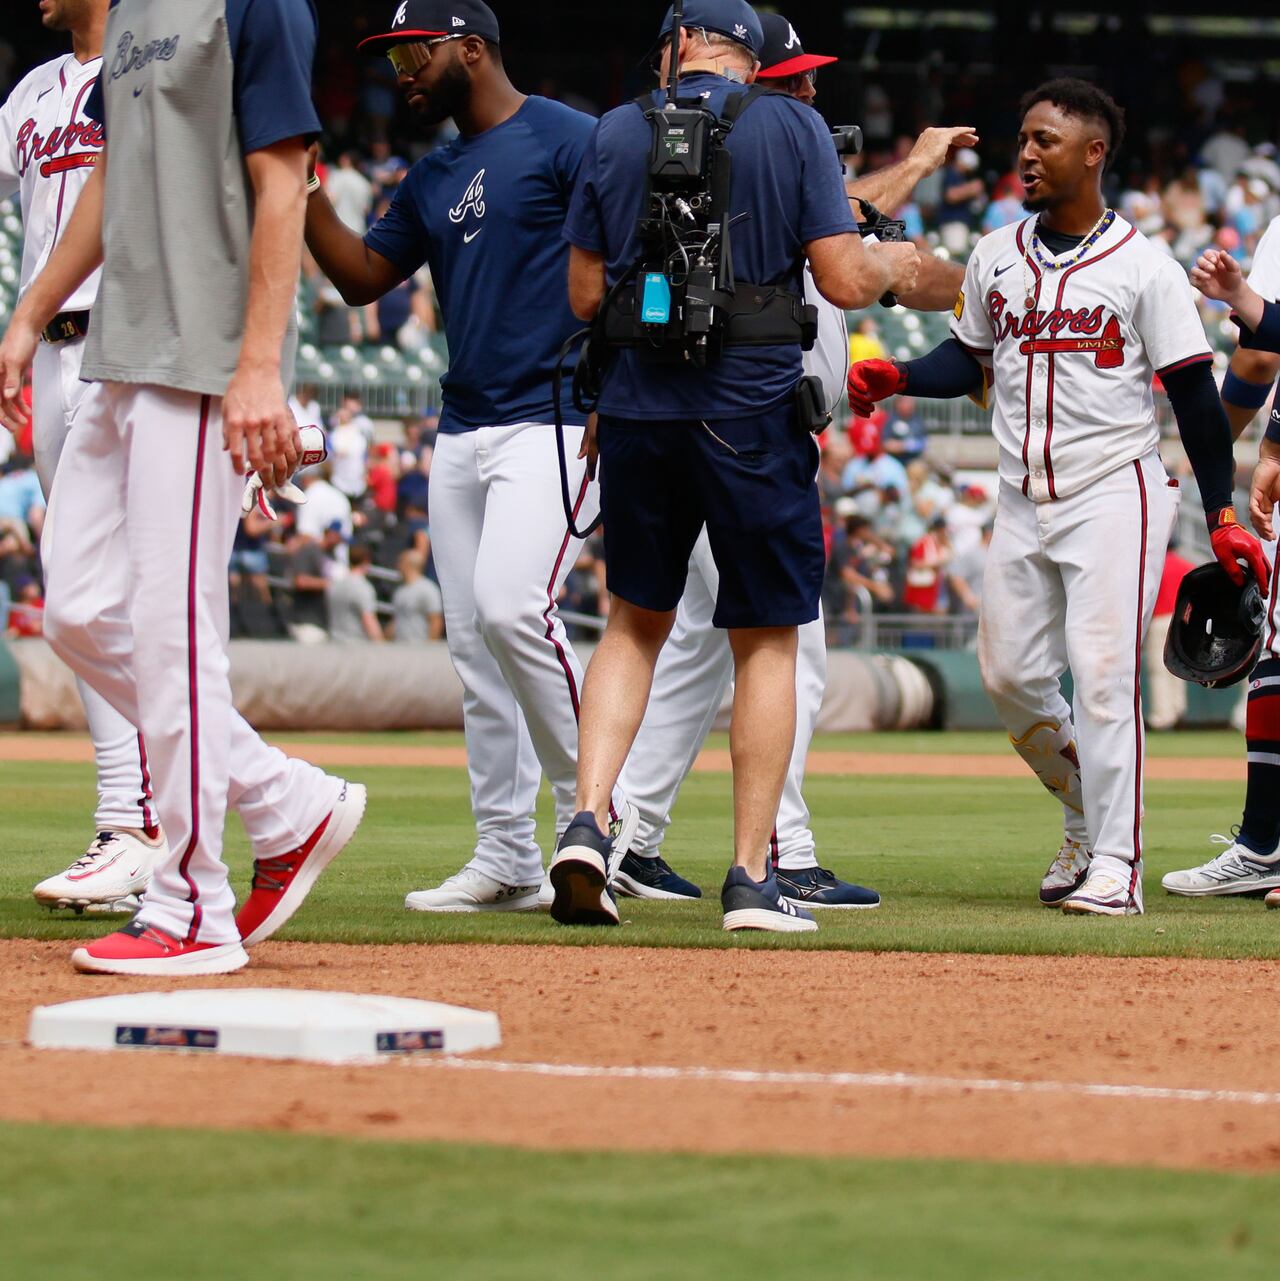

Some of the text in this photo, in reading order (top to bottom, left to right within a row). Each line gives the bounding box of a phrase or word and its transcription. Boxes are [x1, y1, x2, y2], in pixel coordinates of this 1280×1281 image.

[107, 30, 180, 84] Braves
[17, 117, 107, 178] Brave
[448, 168, 486, 224] A
[61, 320, 75, 336] 28
[988, 290, 1106, 345] Braves
